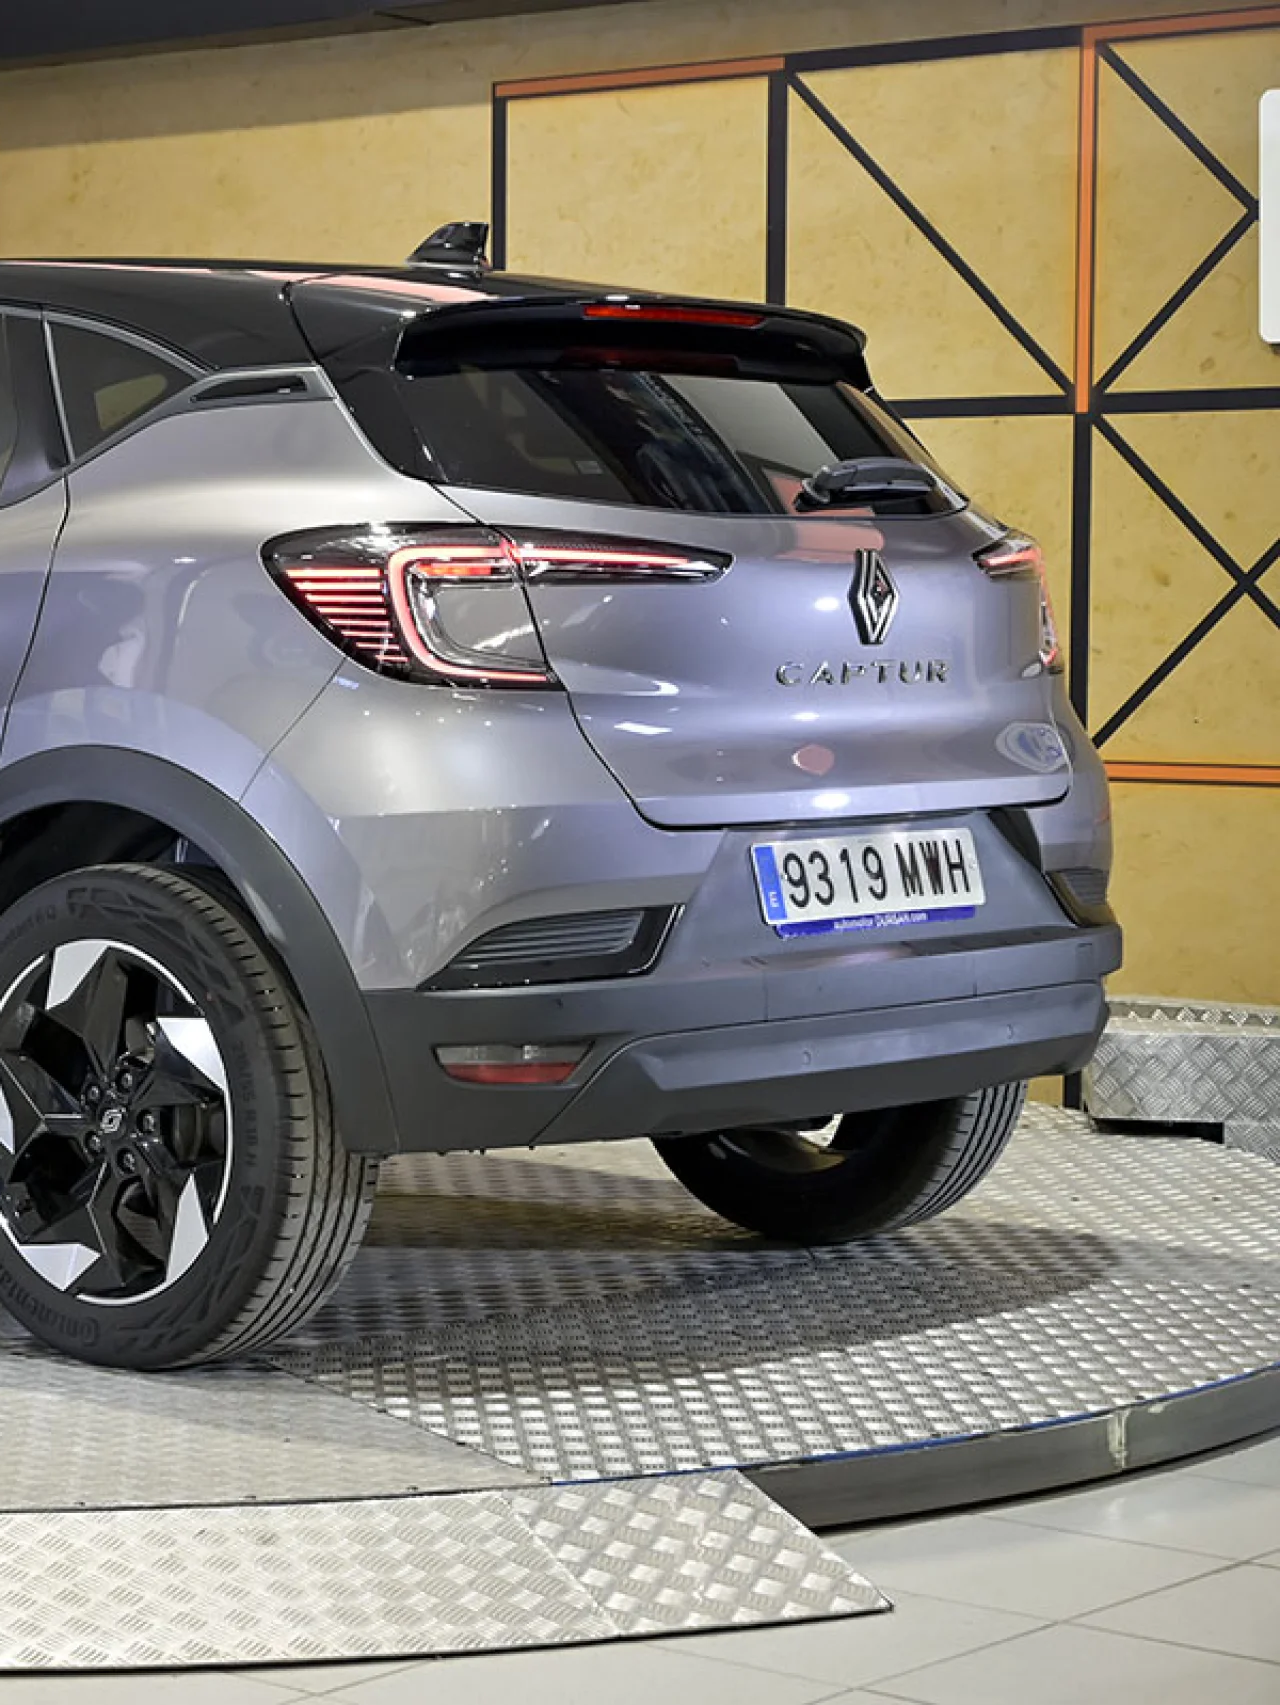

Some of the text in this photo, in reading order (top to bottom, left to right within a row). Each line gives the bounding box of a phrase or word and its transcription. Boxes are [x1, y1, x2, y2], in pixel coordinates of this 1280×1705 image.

[775, 658, 950, 687] CAPTUR
[782, 838, 971, 909] 9319 MWH
[767, 891, 780, 908] E
